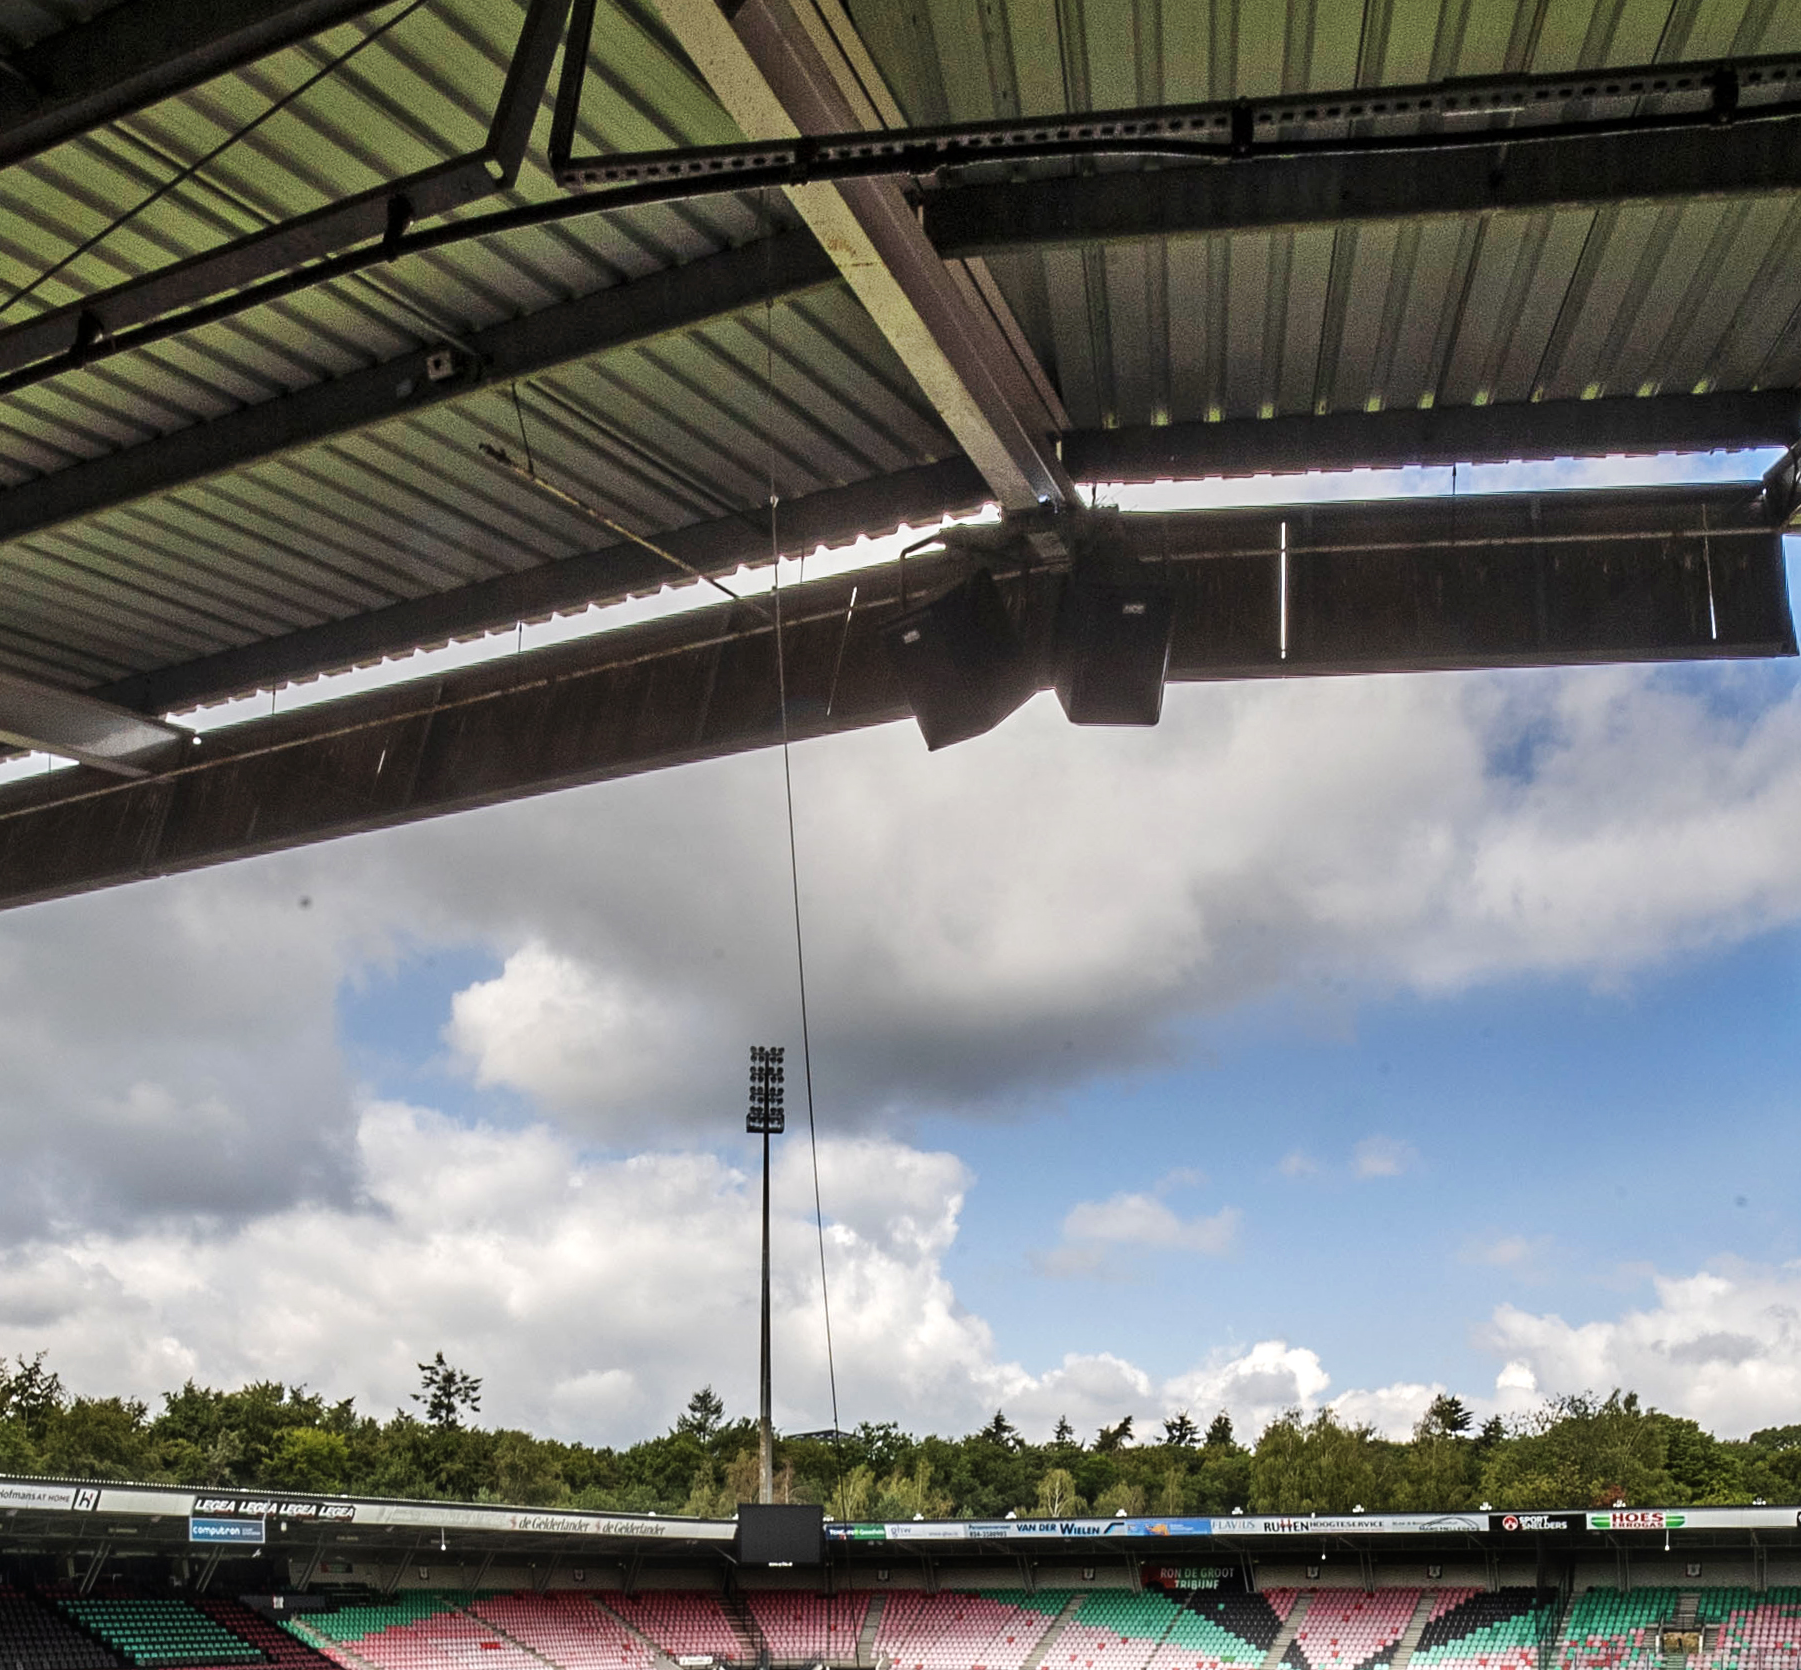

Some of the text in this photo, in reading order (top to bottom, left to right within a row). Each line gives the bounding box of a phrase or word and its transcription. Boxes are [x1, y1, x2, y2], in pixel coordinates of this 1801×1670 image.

[194, 1499, 236, 1512] LEGEA
[238, 1501, 279, 1514] LEGEA
[279, 1503, 318, 1515] LEGEA
[318, 1505, 355, 1518] LEGEA
[1611, 1512, 1664, 1522] HOES
[531, 1517, 591, 1533] Gelderlander
[613, 1521, 667, 1536] Gelderlander
[1016, 1524, 1037, 1533] VAN
[1038, 1523, 1058, 1532] DER
[1309, 1520, 1385, 1529] HOOGTESERVICE
[192, 1526, 241, 1537] computron
[1160, 1567, 1235, 1579] RON DE GROOT
